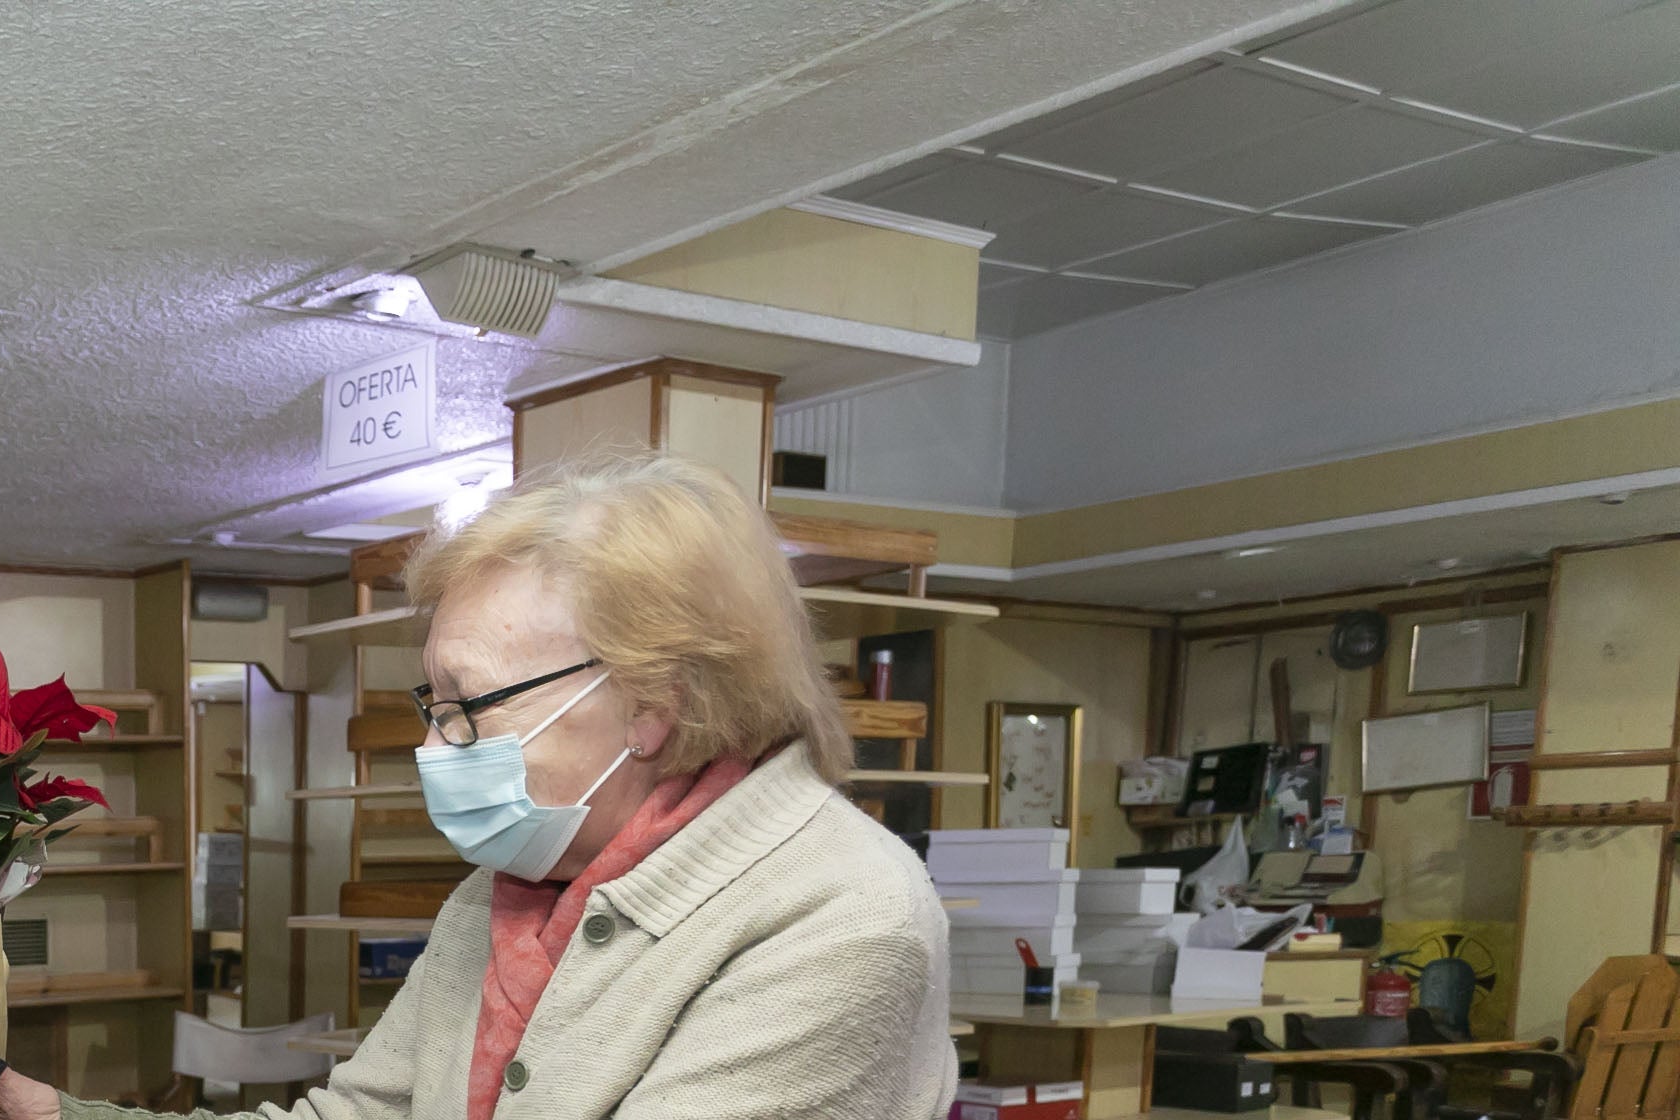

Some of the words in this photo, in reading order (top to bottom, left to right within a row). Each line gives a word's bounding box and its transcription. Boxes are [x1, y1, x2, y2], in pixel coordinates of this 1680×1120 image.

[339, 363, 418, 408] OFERTA
[349, 416, 377, 446] 40
[382, 411, 402, 440] €
